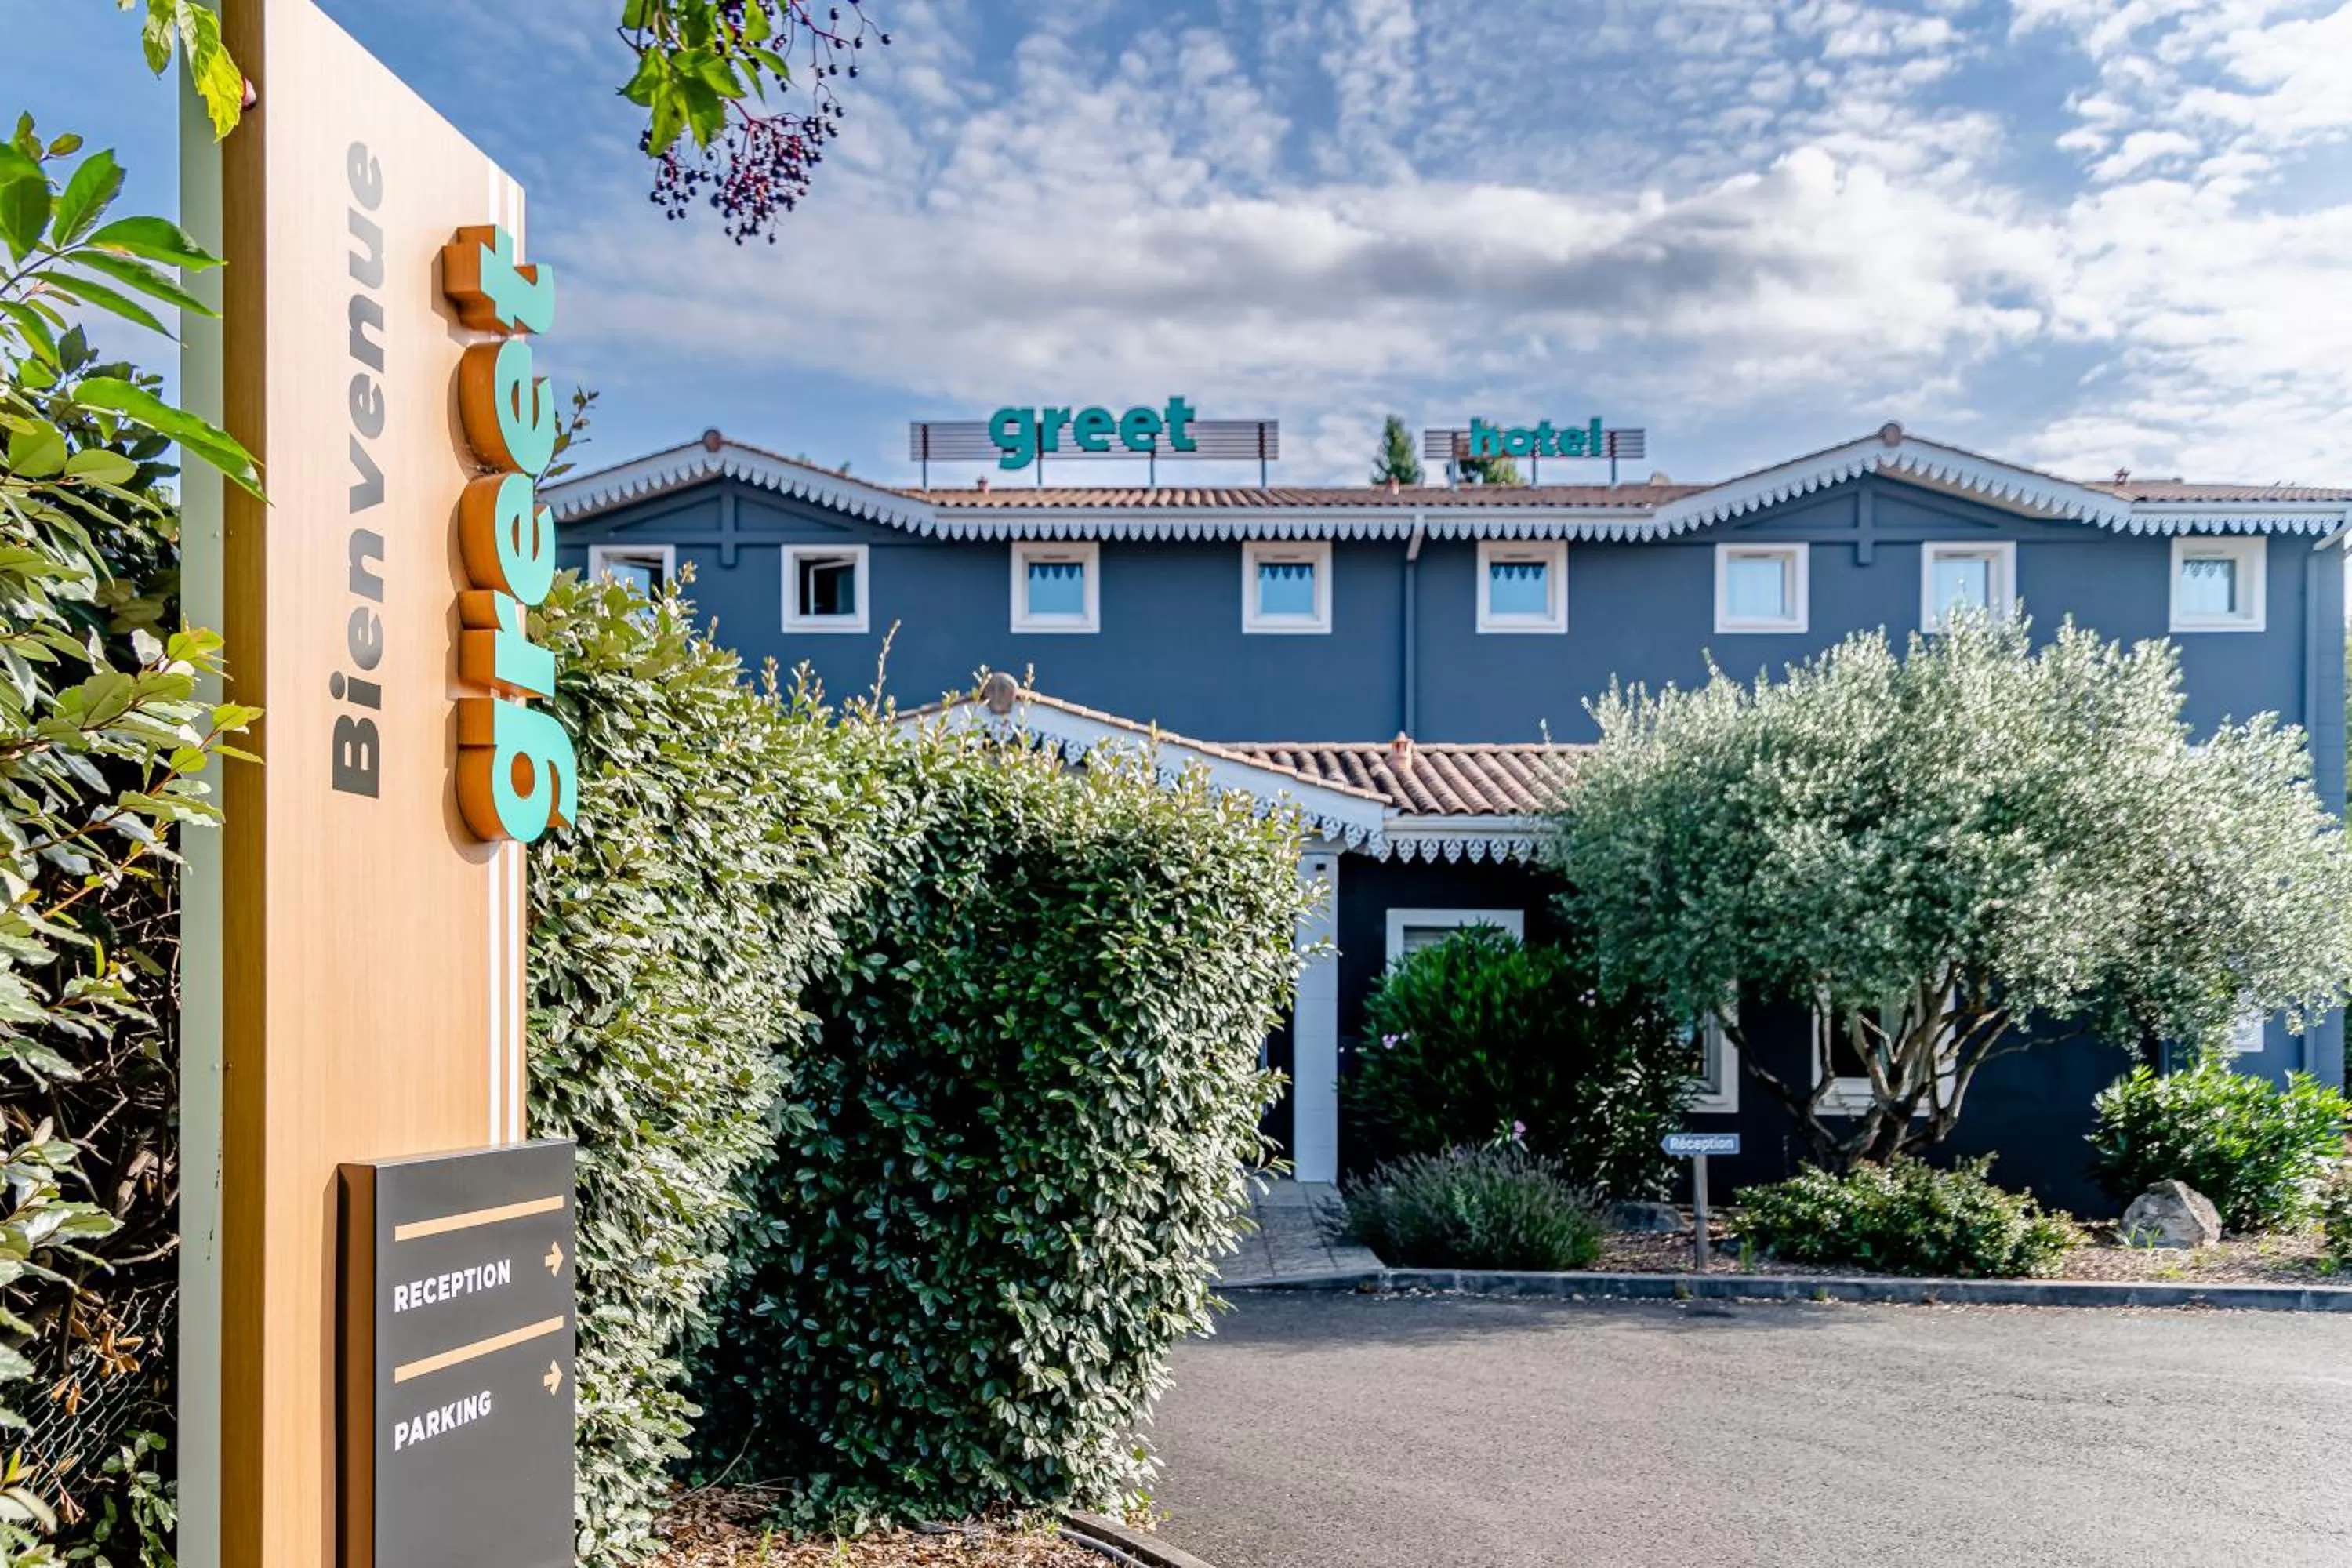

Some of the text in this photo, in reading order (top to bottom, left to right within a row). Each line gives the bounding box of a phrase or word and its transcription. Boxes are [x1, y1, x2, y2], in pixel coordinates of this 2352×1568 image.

[989, 394, 1197, 470] greet
[1468, 416, 1603, 457] hotel
[329, 140, 386, 798] Bienvenue
[443, 224, 578, 844] greet
[1670, 1135, 1733, 1151] Réception
[394, 1259, 511, 1313] RECEPTION
[394, 1390, 492, 1452] PARKING
